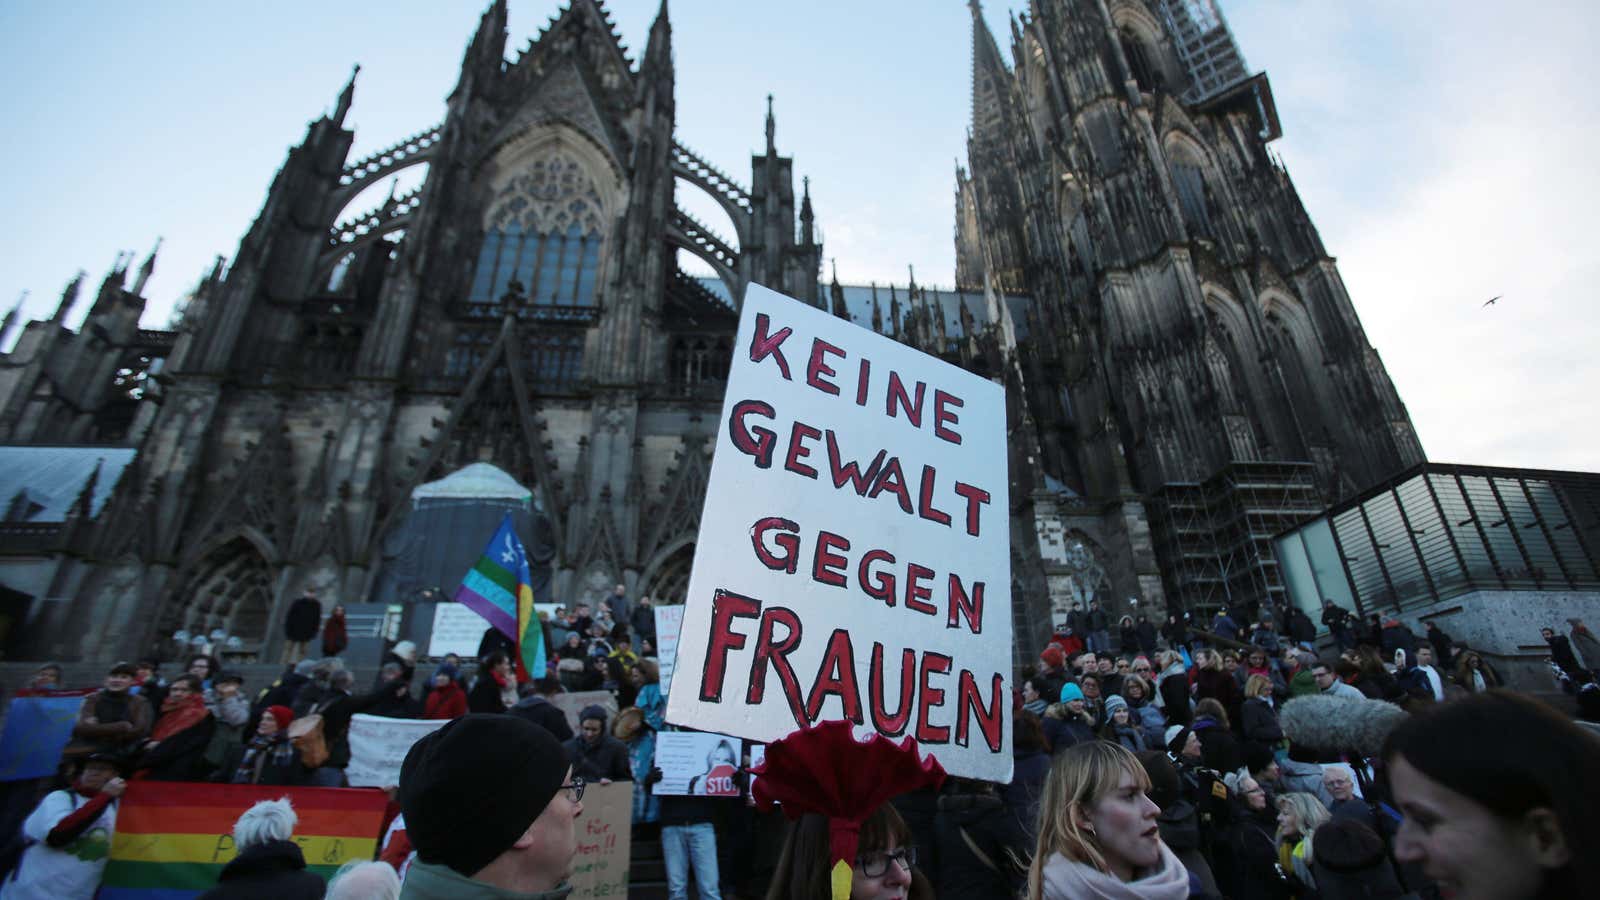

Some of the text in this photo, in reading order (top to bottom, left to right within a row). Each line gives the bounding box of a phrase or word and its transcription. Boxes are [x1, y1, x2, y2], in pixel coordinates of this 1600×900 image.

[750, 313, 964, 445] KEINE
[729, 399, 991, 537] GEWALT
[750, 517, 985, 634] GEGEN
[699, 588, 1004, 753] FRAUEN
[707, 776, 736, 793] STO
